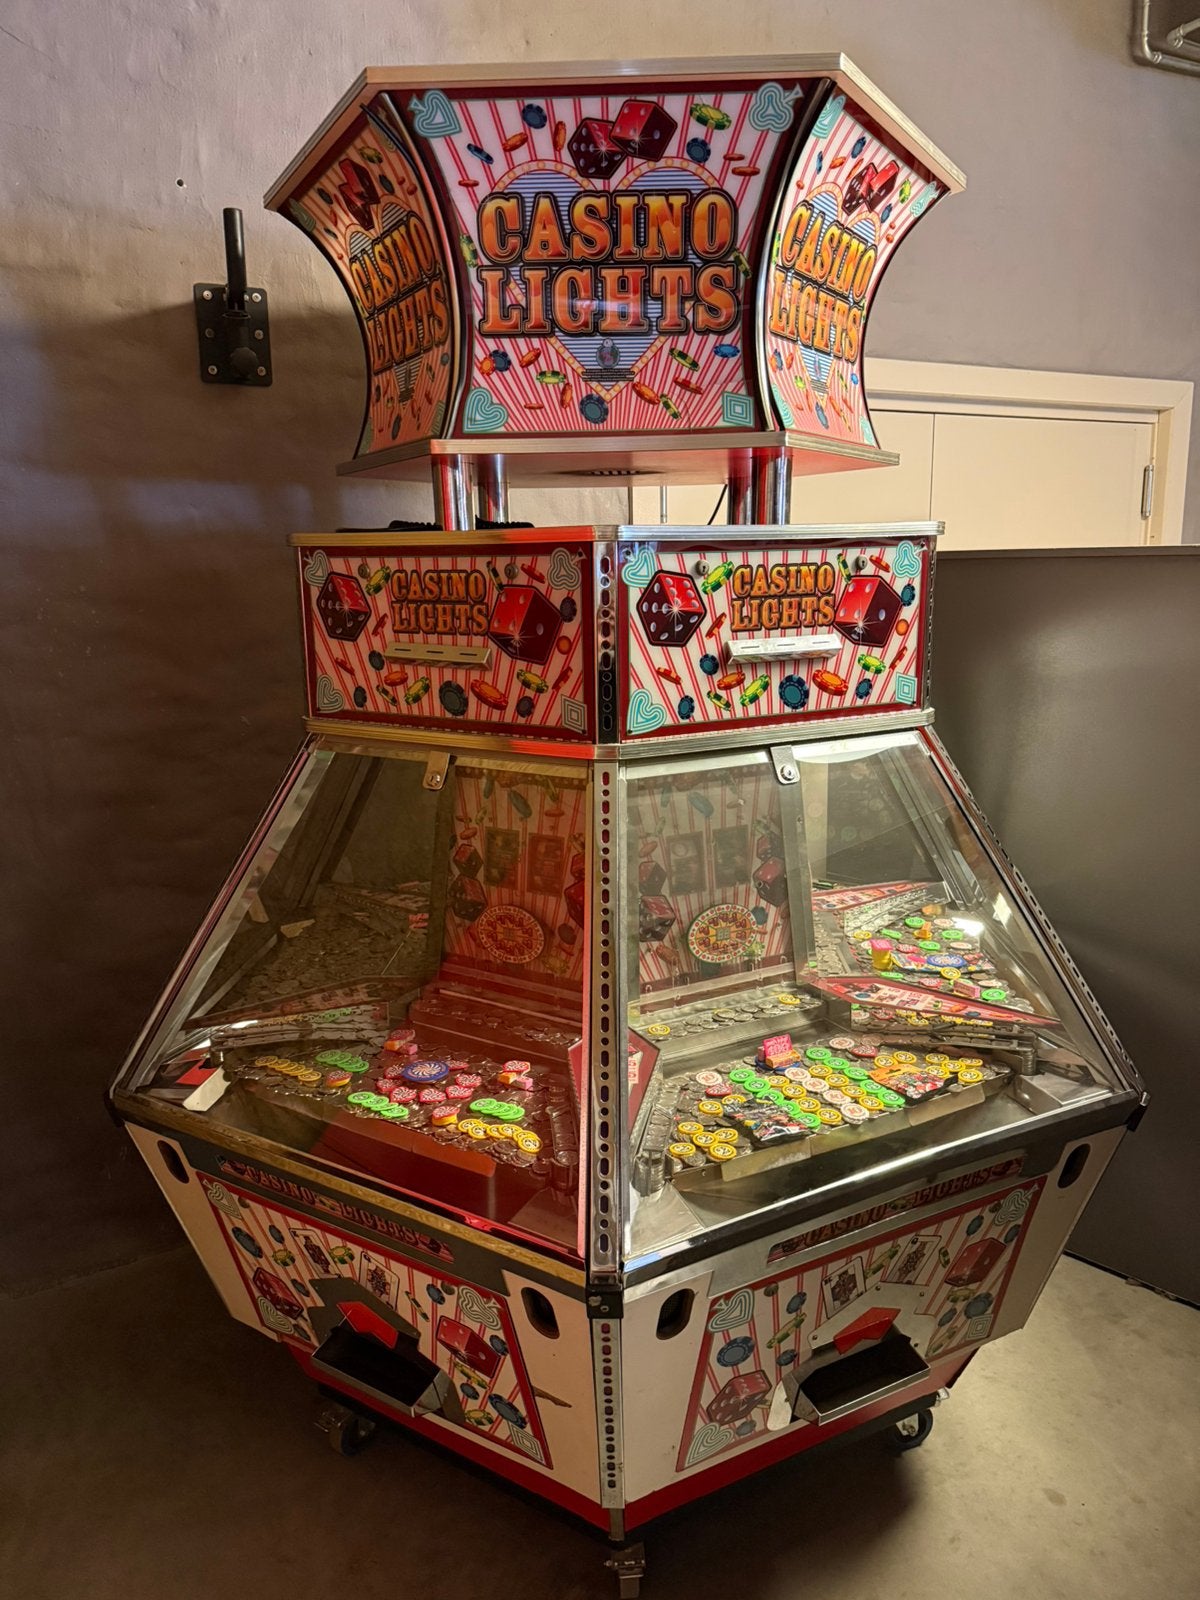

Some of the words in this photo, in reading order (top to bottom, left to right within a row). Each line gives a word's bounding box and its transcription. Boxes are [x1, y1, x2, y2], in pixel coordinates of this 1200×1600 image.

[350, 211, 436, 315] CASINO
[477, 189, 738, 264] CASINO
[781, 200, 878, 303] CASINO
[366, 277, 450, 376] LIGHTS
[477, 263, 741, 336] LIGHTS
[769, 264, 862, 364] LIGHTS
[391, 569, 486, 601] CASINO
[731, 594, 836, 632] LIGHTS
[733, 562, 835, 598] CASINO
[391, 600, 489, 635] LIGHTS
[244, 1165, 316, 1206] CASINO
